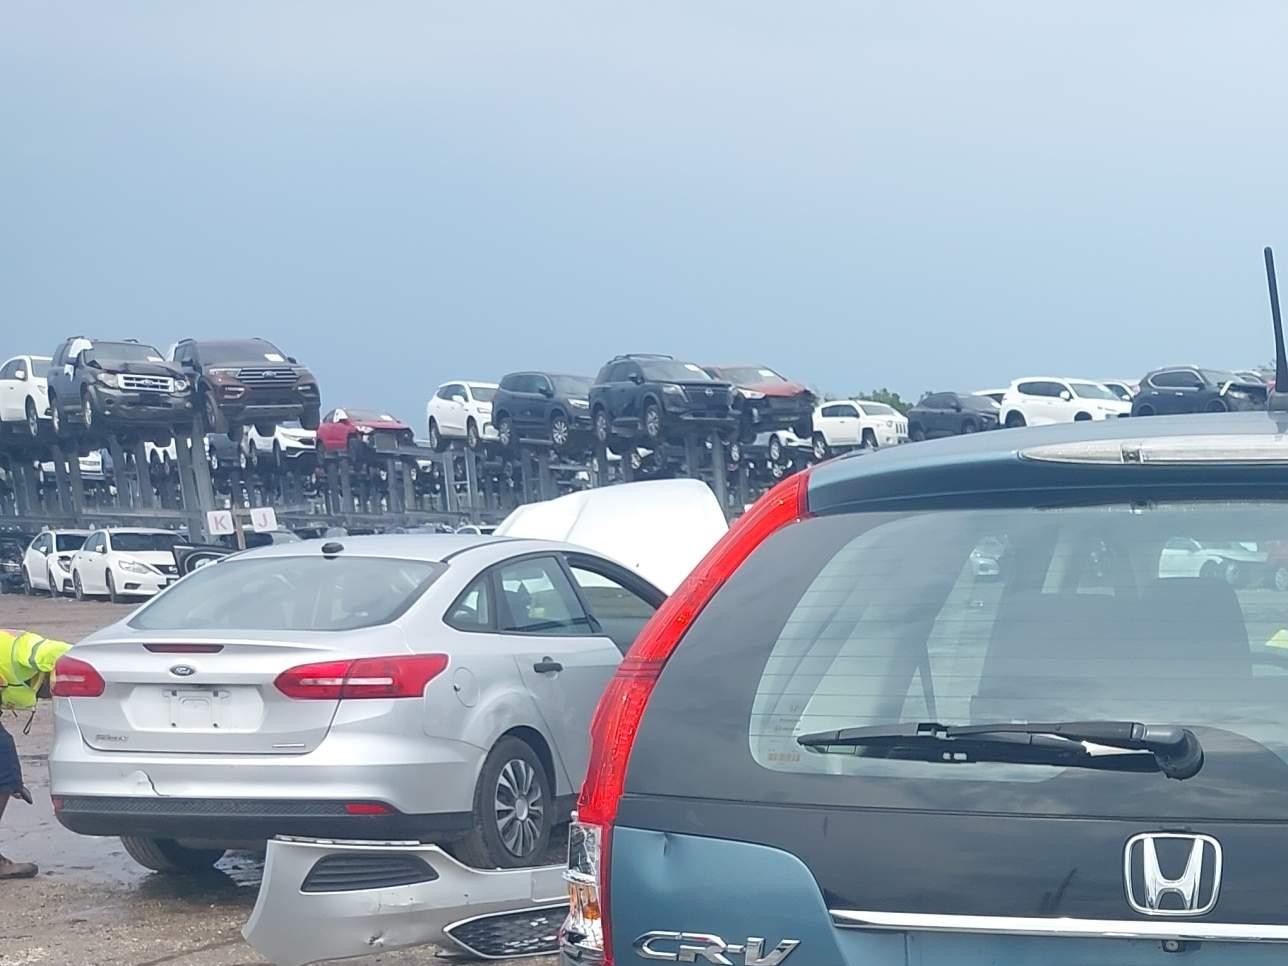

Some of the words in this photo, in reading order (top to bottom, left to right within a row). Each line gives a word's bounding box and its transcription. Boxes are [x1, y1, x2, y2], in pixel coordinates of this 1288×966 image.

[214, 515, 228, 530] K
[258, 512, 269, 528] J
[632, 930, 801, 966] CR-V
